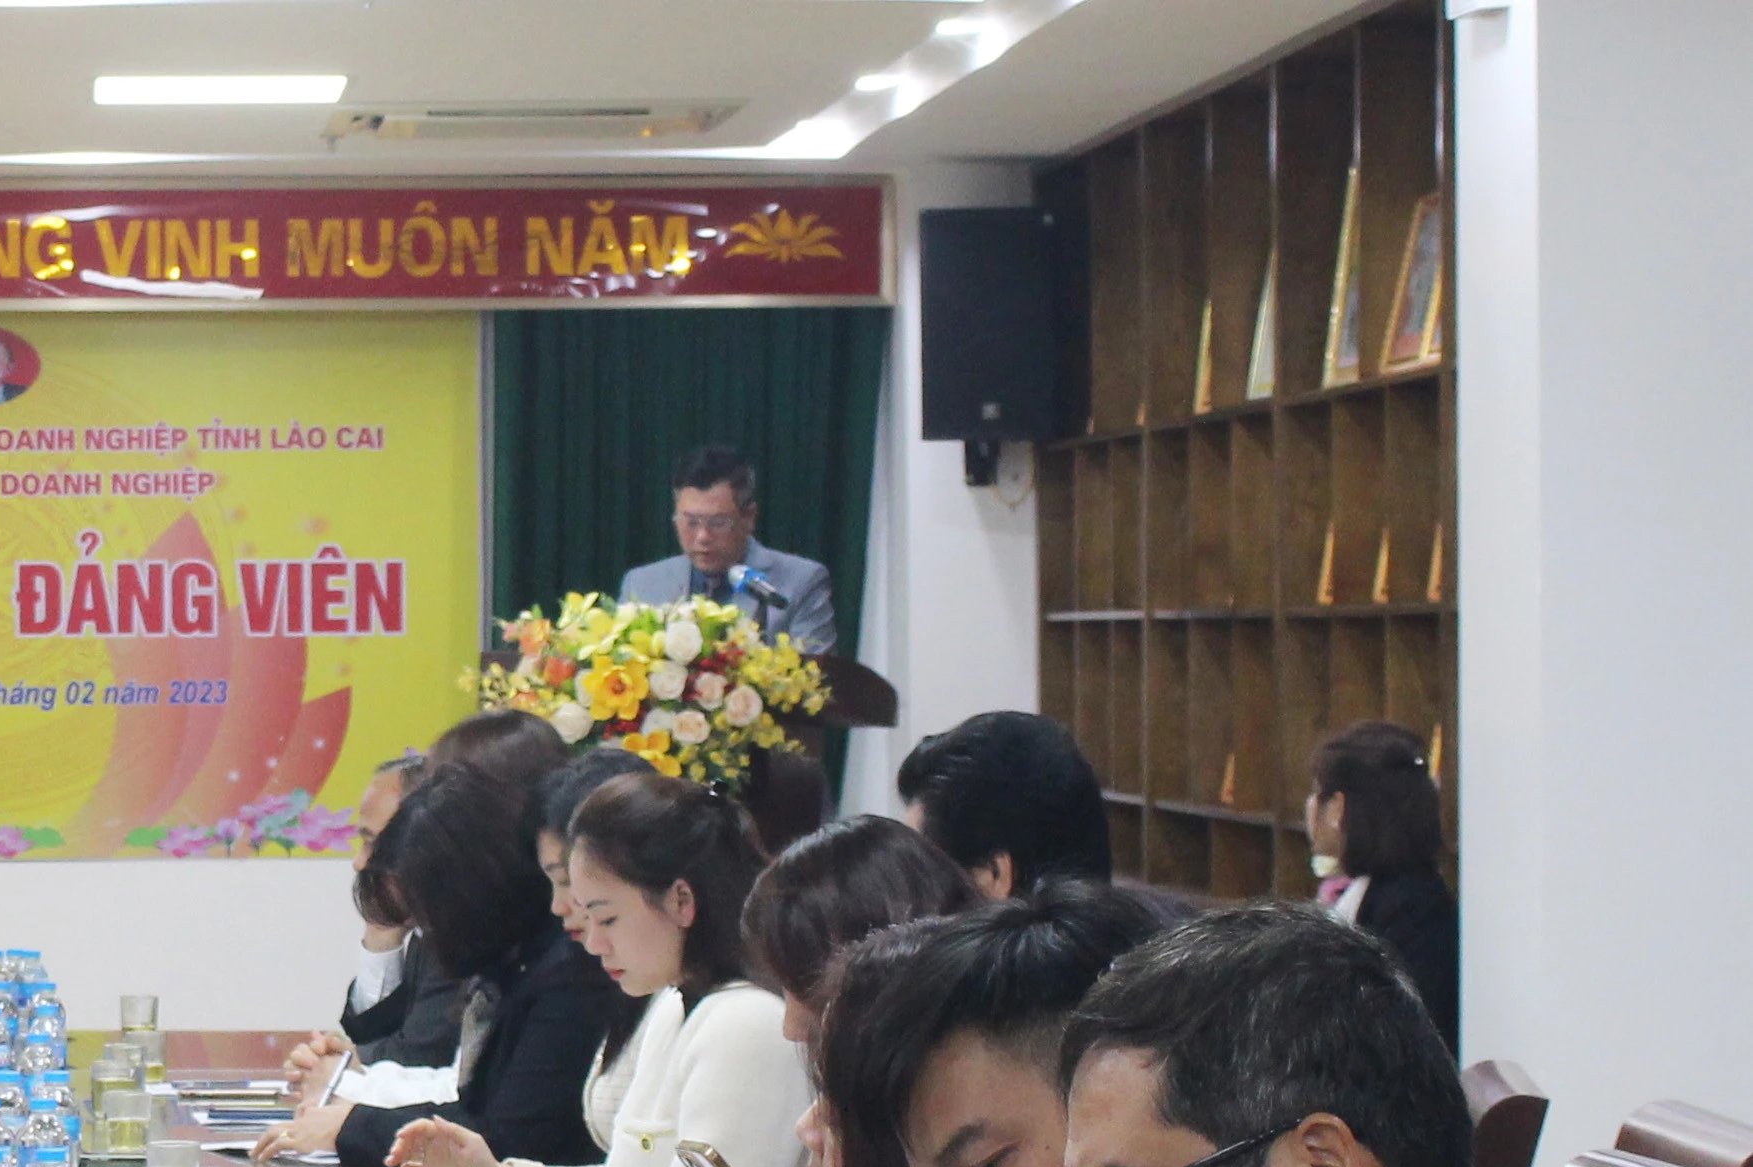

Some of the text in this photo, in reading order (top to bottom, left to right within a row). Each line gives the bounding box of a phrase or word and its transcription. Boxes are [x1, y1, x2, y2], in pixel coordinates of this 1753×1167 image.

[95, 218, 260, 279] VINH
[286, 200, 496, 279] MUÔN
[526, 200, 691, 277] NĂM
[84, 421, 188, 457] NGHIỆP
[336, 427, 384, 450] CAI
[0, 474, 102, 496] DOANH
[111, 466, 216, 503] NGHIỆP
[13, 530, 219, 638] ĐẢNG
[238, 543, 406, 637] VIÊN
[65, 680, 96, 705] 02
[167, 680, 229, 705] 2023
